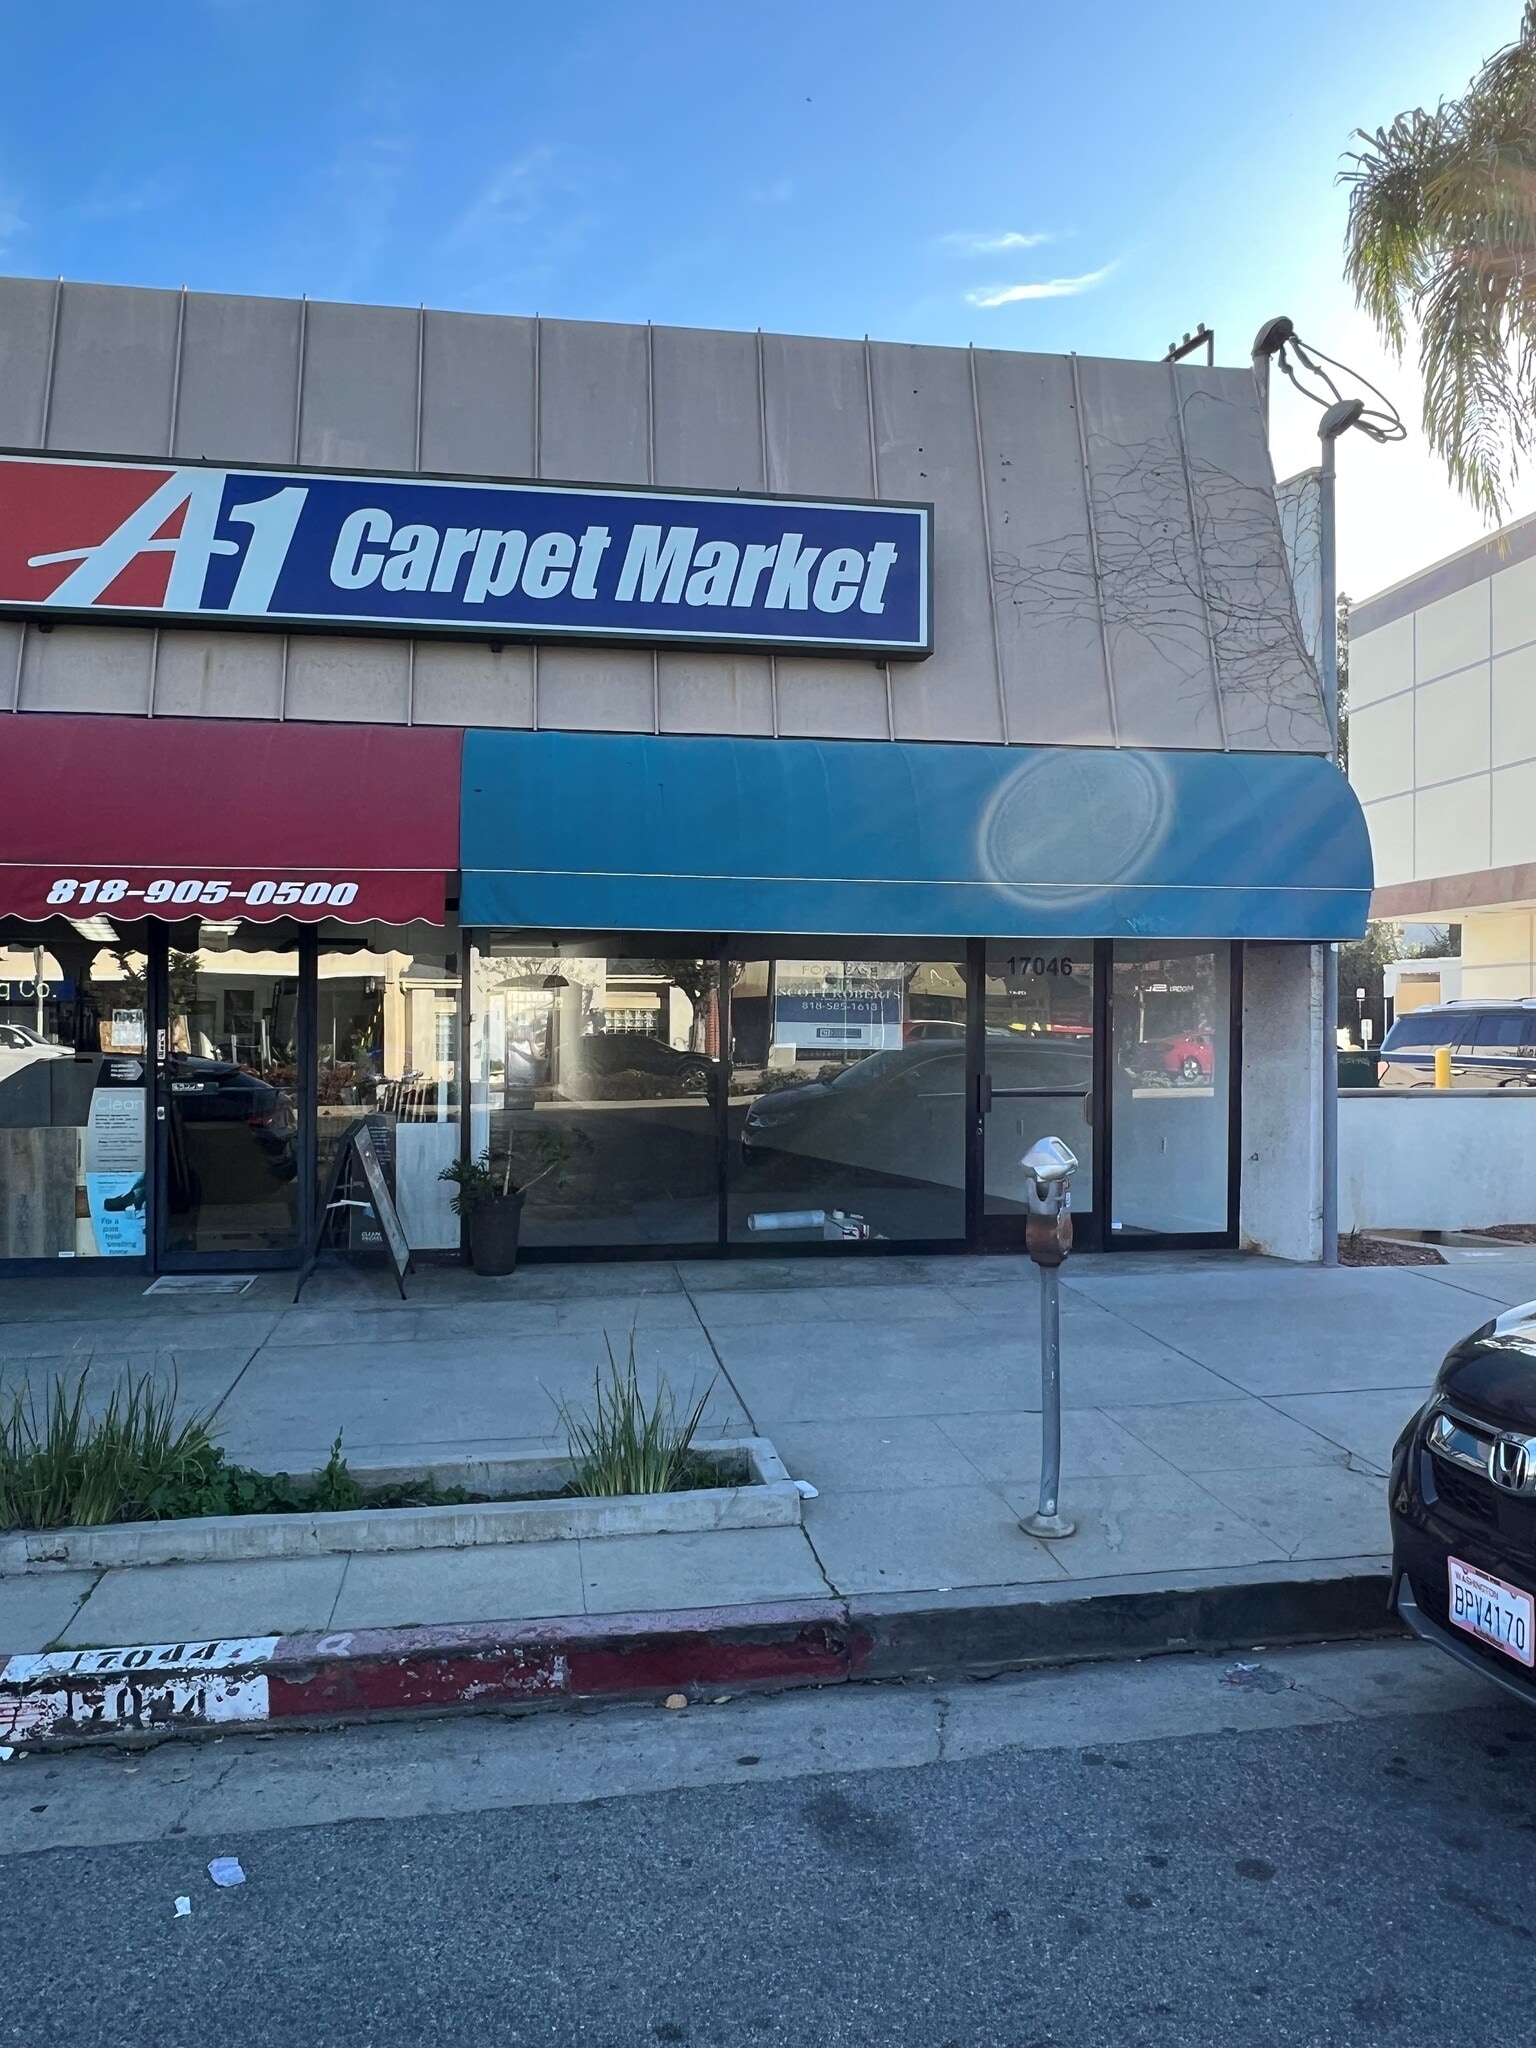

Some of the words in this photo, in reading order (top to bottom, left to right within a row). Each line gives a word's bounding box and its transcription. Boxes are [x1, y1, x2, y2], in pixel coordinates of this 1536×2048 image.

[330, 507, 609, 603] Carpet
[616, 524, 898, 615] Market
[46, 878, 359, 906] 818-905-0500
[802, 965, 829, 976] FOR
[1006, 956, 1073, 976] 17046
[1455, 1571, 1499, 1600] WASHINGTON
[1455, 1583, 1525, 1650] BPV4170
[69, 1641, 221, 1669] 17044
